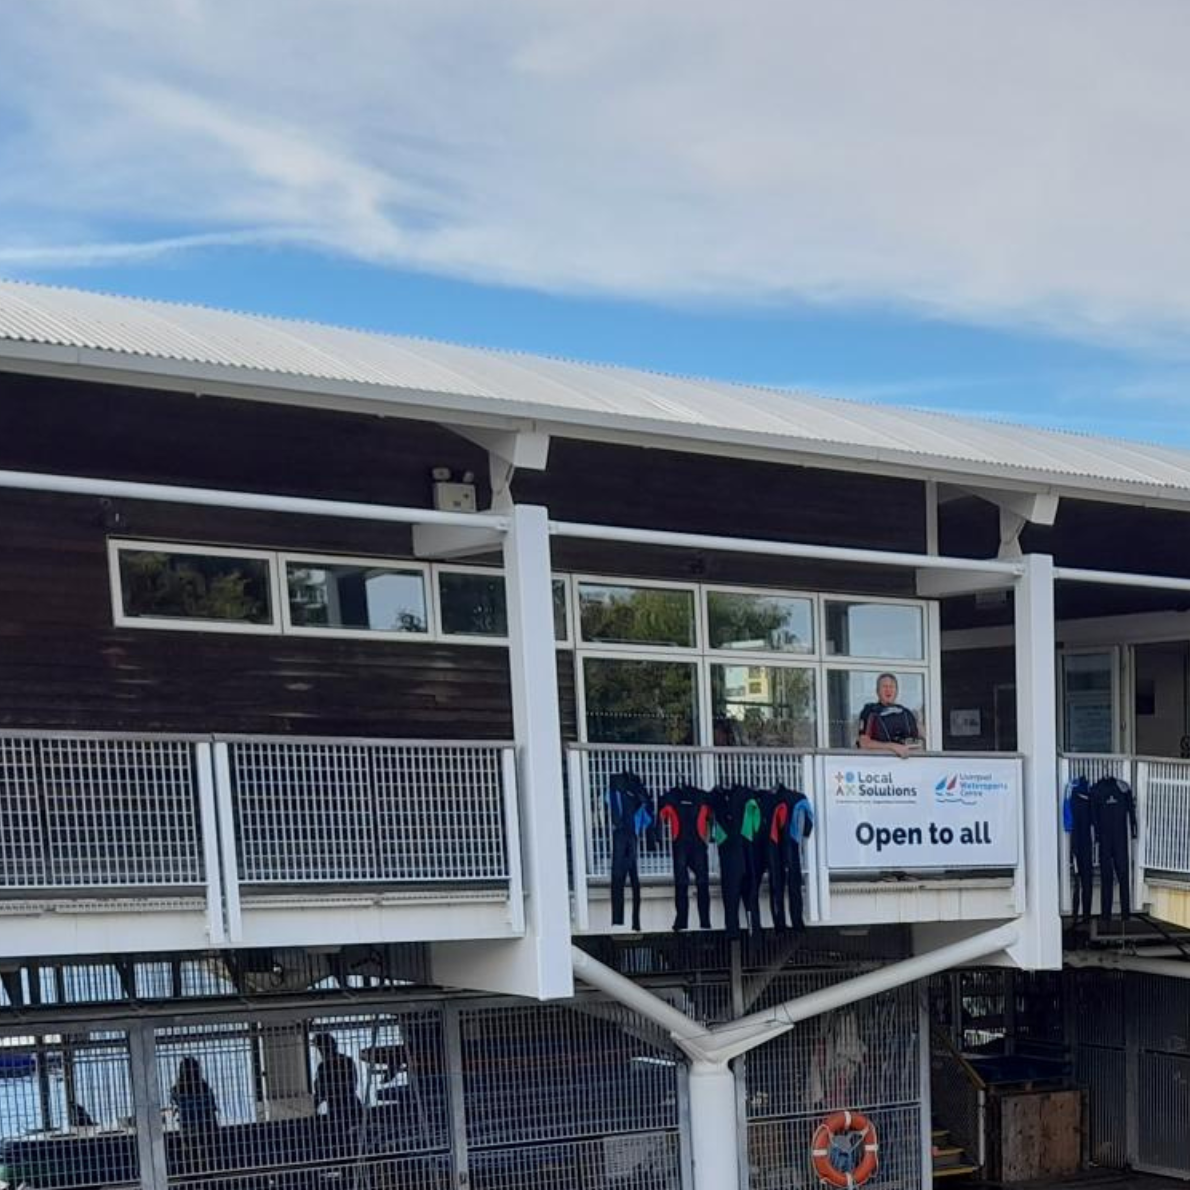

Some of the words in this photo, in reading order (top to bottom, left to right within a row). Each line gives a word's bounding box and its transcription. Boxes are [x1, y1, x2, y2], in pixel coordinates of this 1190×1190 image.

[857, 771, 893, 783] Local
[858, 784, 917, 796] Solutions
[855, 822, 922, 852] Open
[929, 822, 954, 845] to
[960, 821, 991, 845] all
